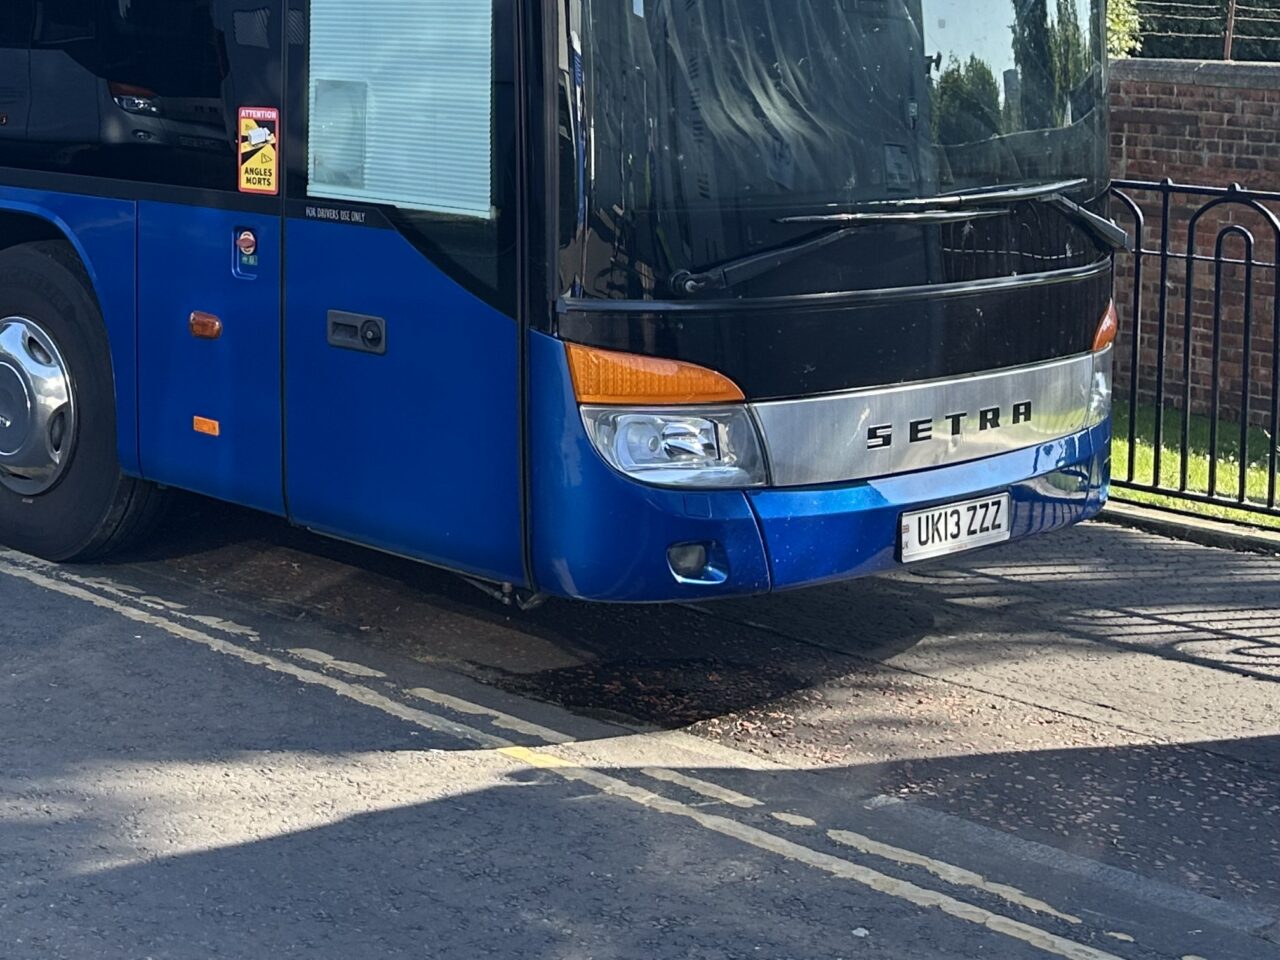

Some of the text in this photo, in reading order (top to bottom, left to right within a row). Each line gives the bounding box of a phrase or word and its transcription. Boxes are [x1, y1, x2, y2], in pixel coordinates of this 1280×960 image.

[241, 109, 276, 120] ATTENTION
[244, 167, 272, 177] ANGLES
[245, 176, 271, 187] MORTS
[305, 206, 366, 222] FOR DRIVERS USE ONLY
[867, 400, 1032, 450] SETRA
[918, 500, 1001, 547] UK13 ZZZ
